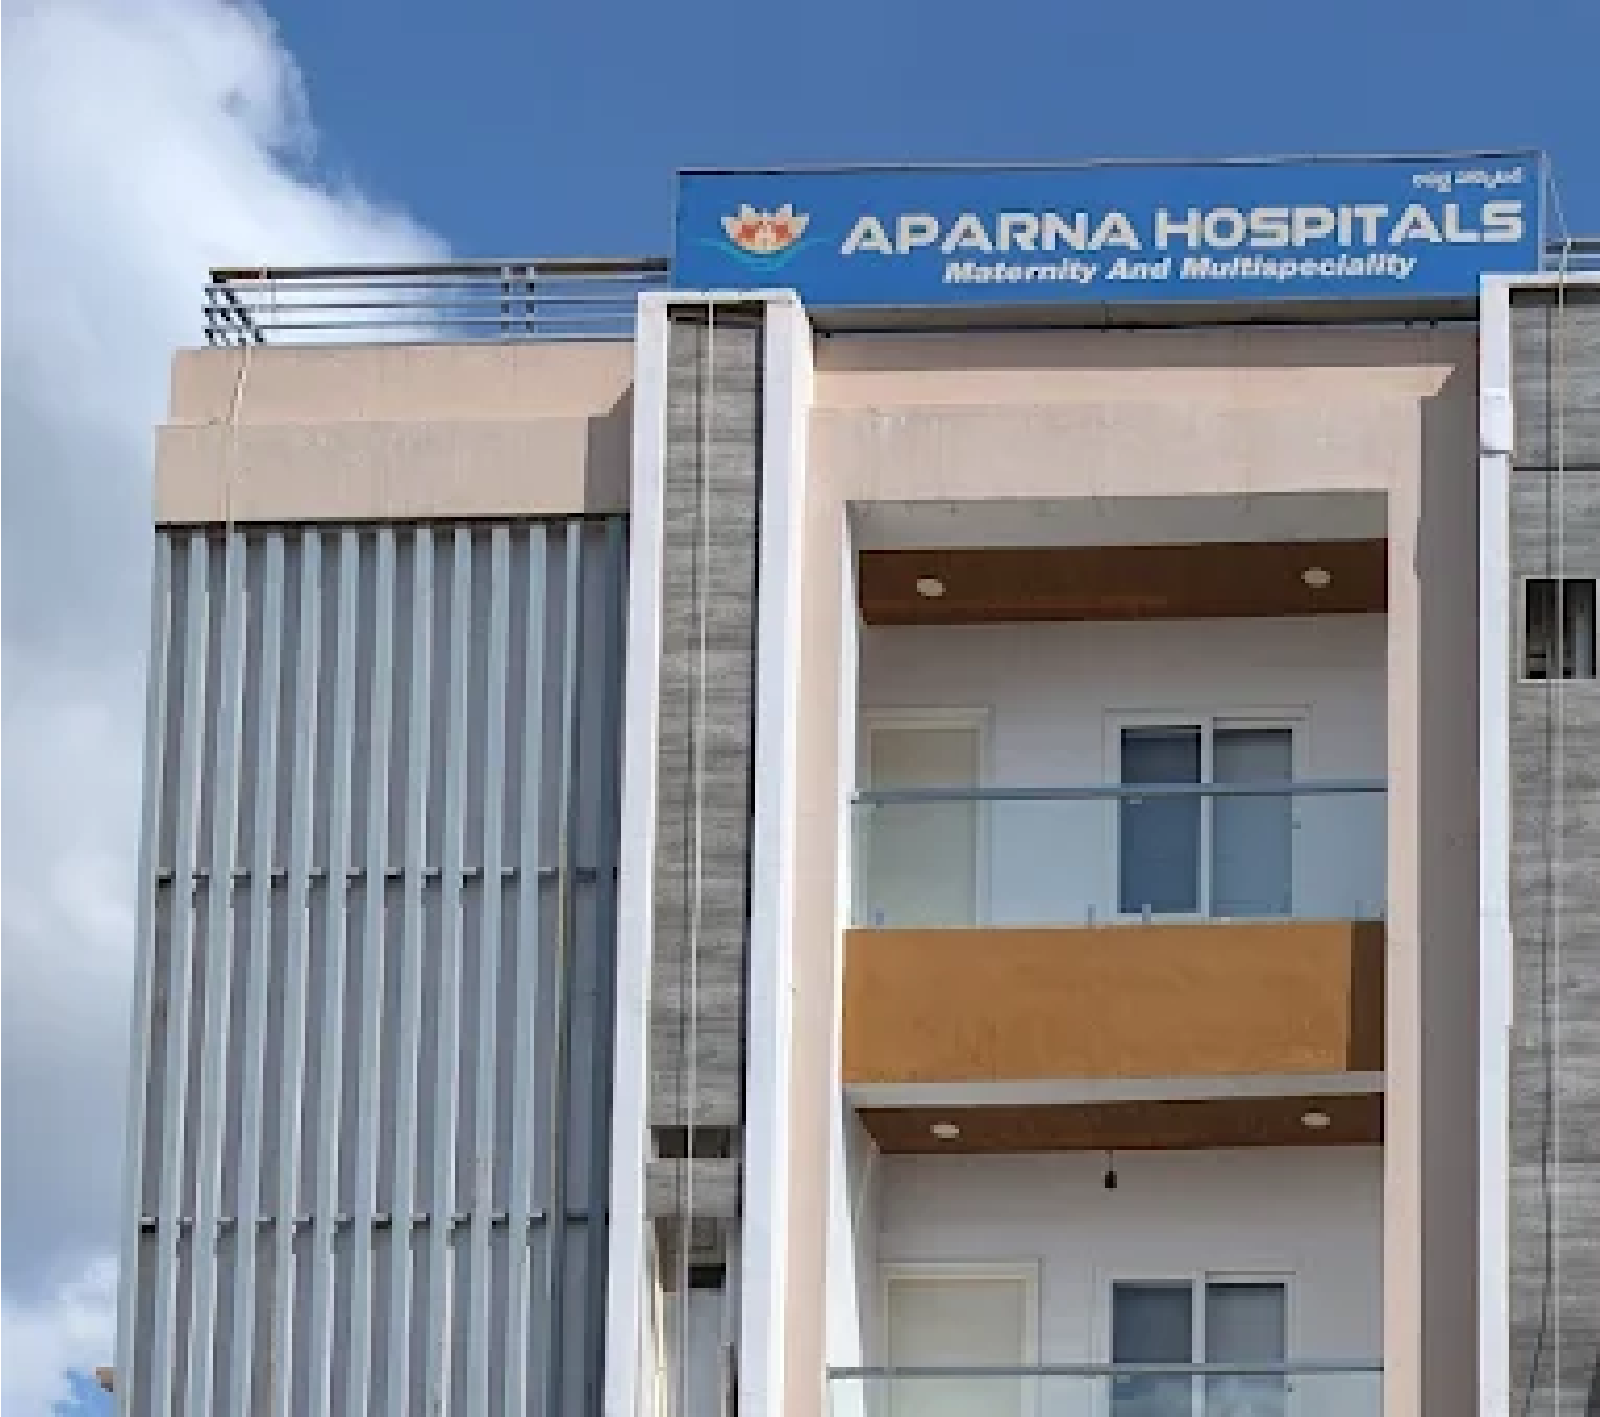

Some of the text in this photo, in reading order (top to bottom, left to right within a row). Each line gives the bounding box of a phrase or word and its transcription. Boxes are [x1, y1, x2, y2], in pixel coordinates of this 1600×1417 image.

[840, 202, 1524, 254] APARNA HOSPITALS
[943, 253, 1416, 284] Maternity And Multispeciality
